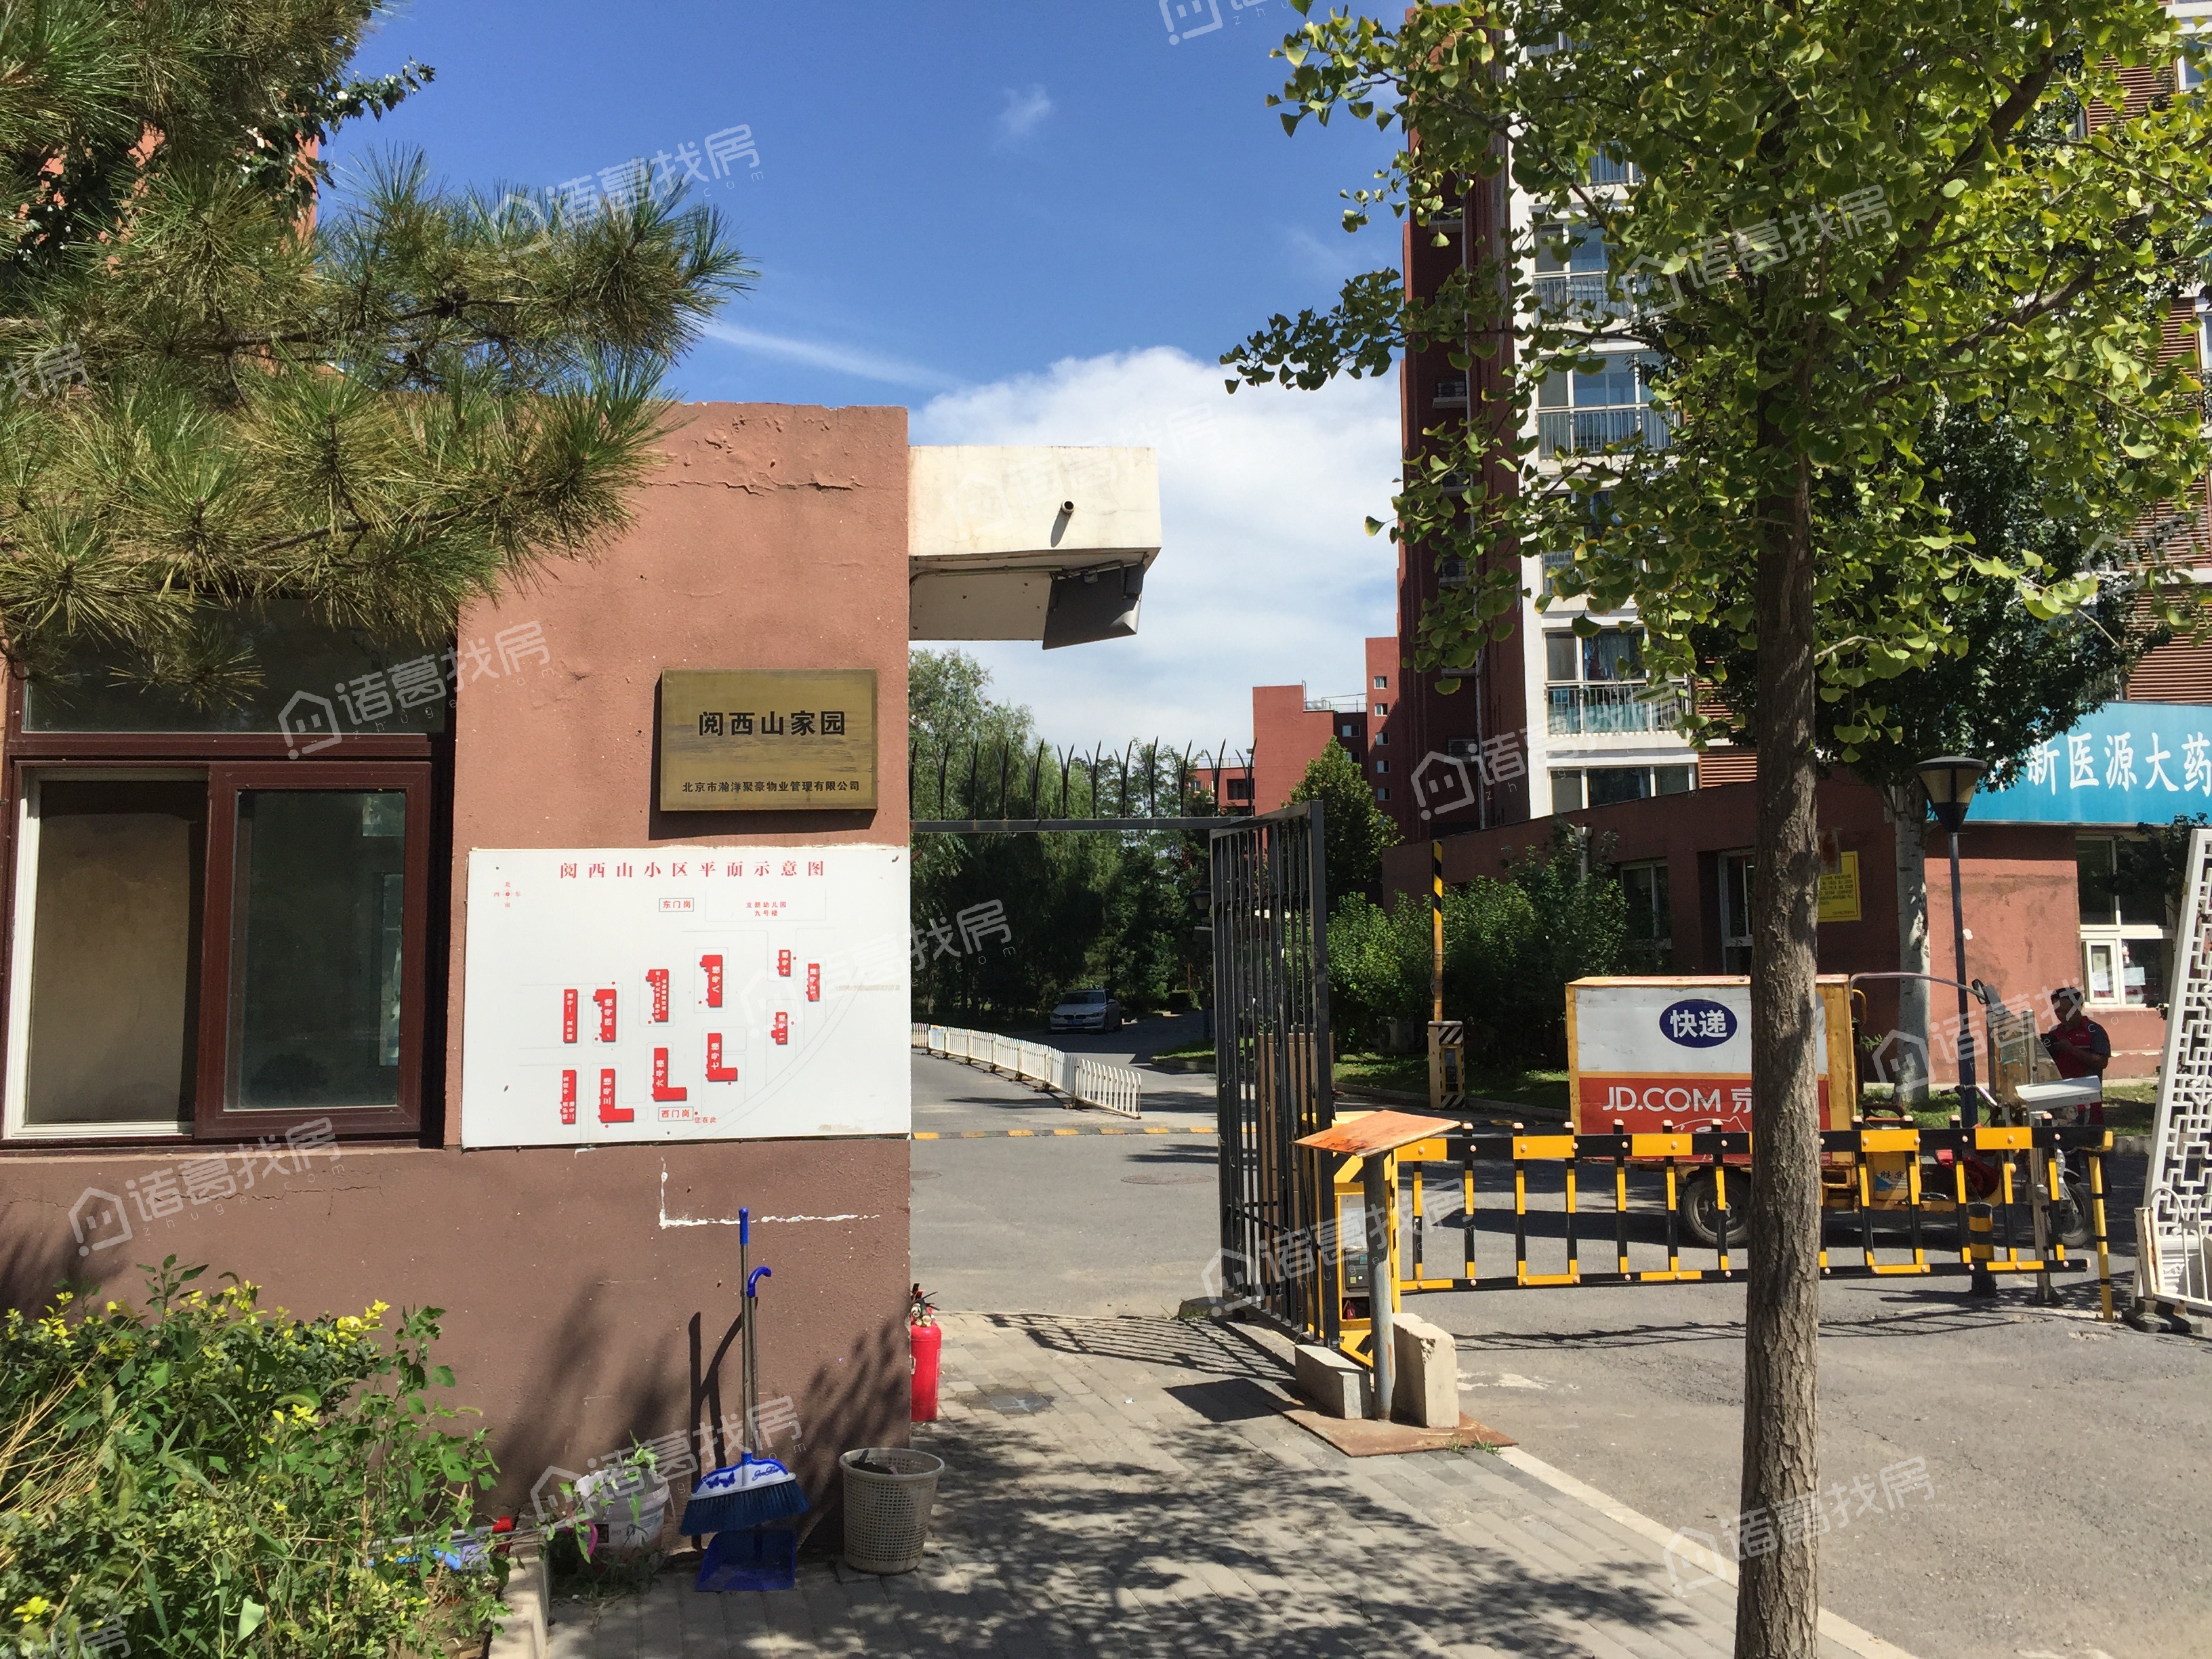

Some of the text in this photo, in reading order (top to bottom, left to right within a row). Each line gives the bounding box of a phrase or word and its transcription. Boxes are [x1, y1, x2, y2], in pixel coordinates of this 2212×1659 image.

[699, 710, 845, 737] 阅西山家园
[682, 781, 860, 793] 北京市瀚洋聚豪物业管理有限公司
[560, 861, 824, 879] 阅西山小区平面示意图
[663, 900, 691, 909] 东门岗
[712, 966, 720, 994] 八号楼
[808, 968, 817, 997] 12号楼
[605, 998, 613, 1026] 四号楼
[1670, 1009, 1728, 1038] 快递
[711, 1042, 720, 1070] 七号楼
[655, 1059, 665, 1087] 六号楼
[602, 1077, 612, 1105] 三号楼
[1602, 1086, 1721, 1113] JD.COM
[661, 1109, 691, 1118] 西门岗
[694, 1115, 717, 1124] 您在此
